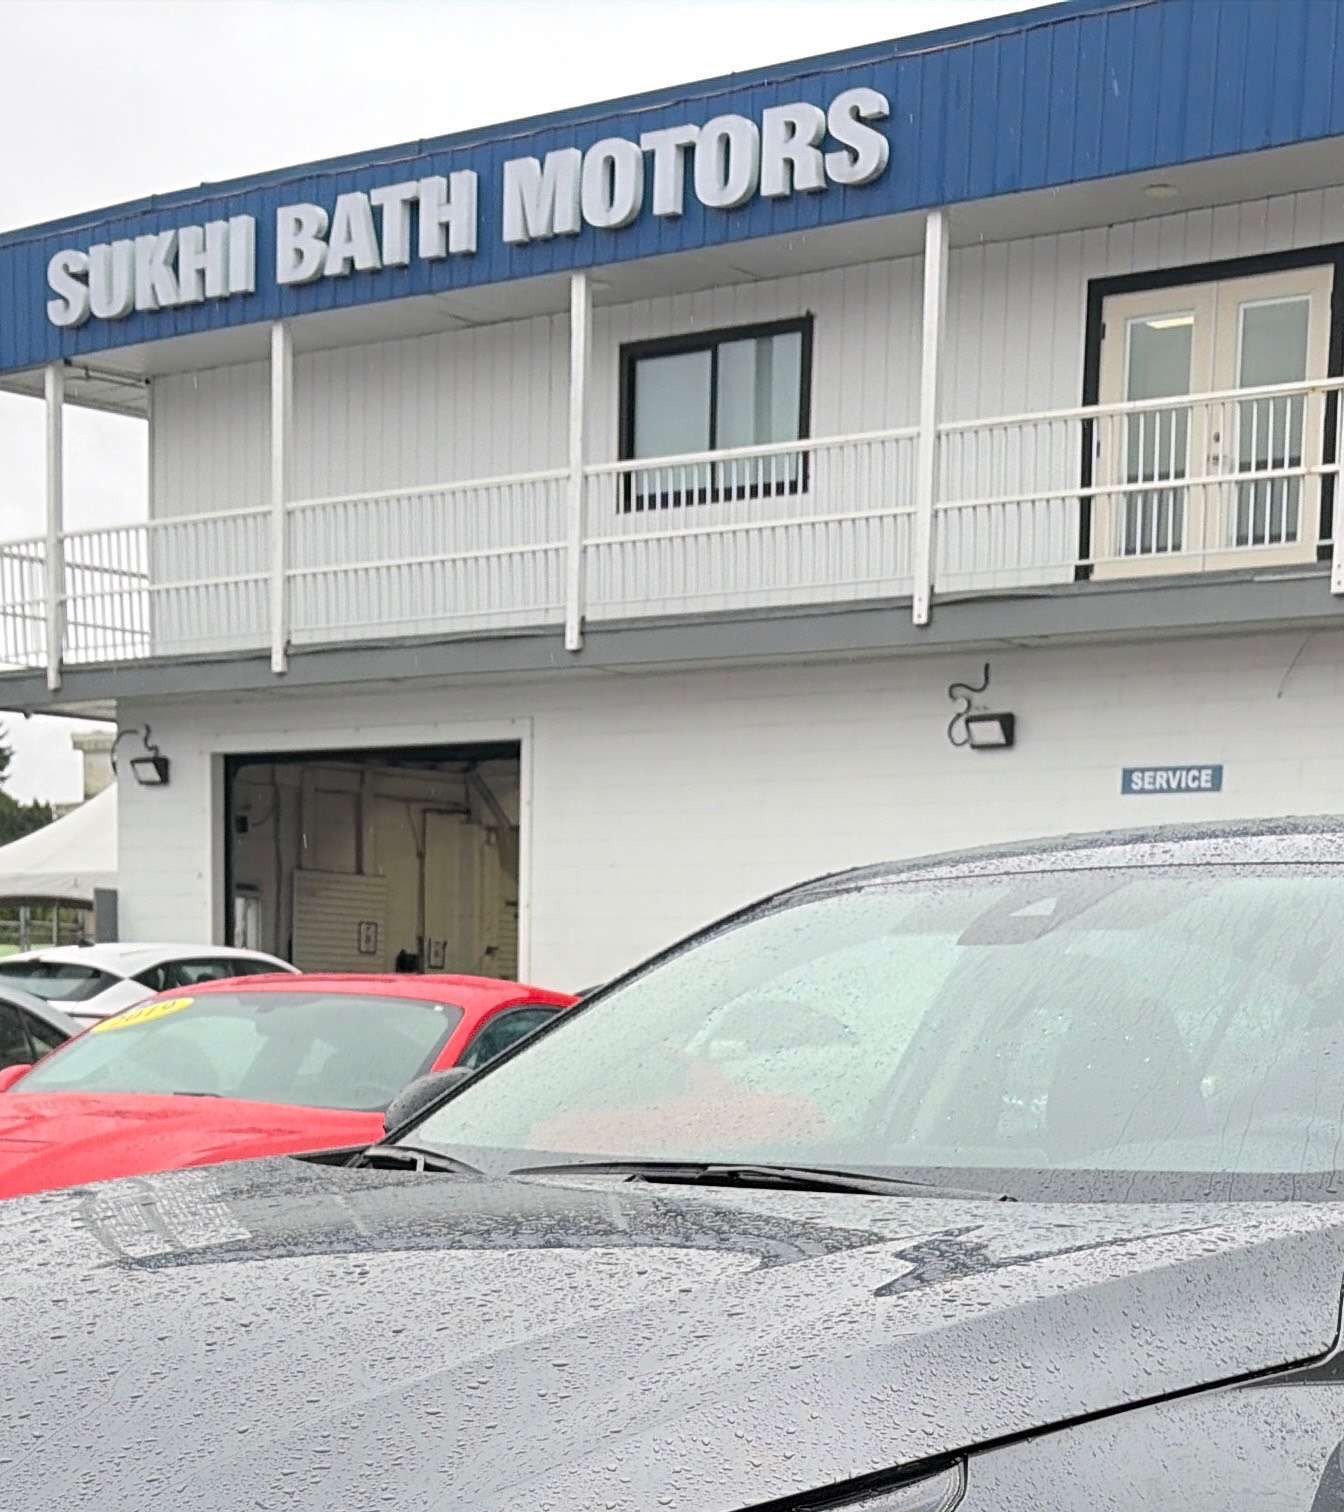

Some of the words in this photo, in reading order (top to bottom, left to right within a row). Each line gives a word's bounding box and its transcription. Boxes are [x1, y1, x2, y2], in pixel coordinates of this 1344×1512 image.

[46, 214, 256, 328] SUKHI
[275, 170, 477, 284] BATH
[502, 87, 890, 245] MOTORS
[1131, 769, 1212, 790] SERVICE
